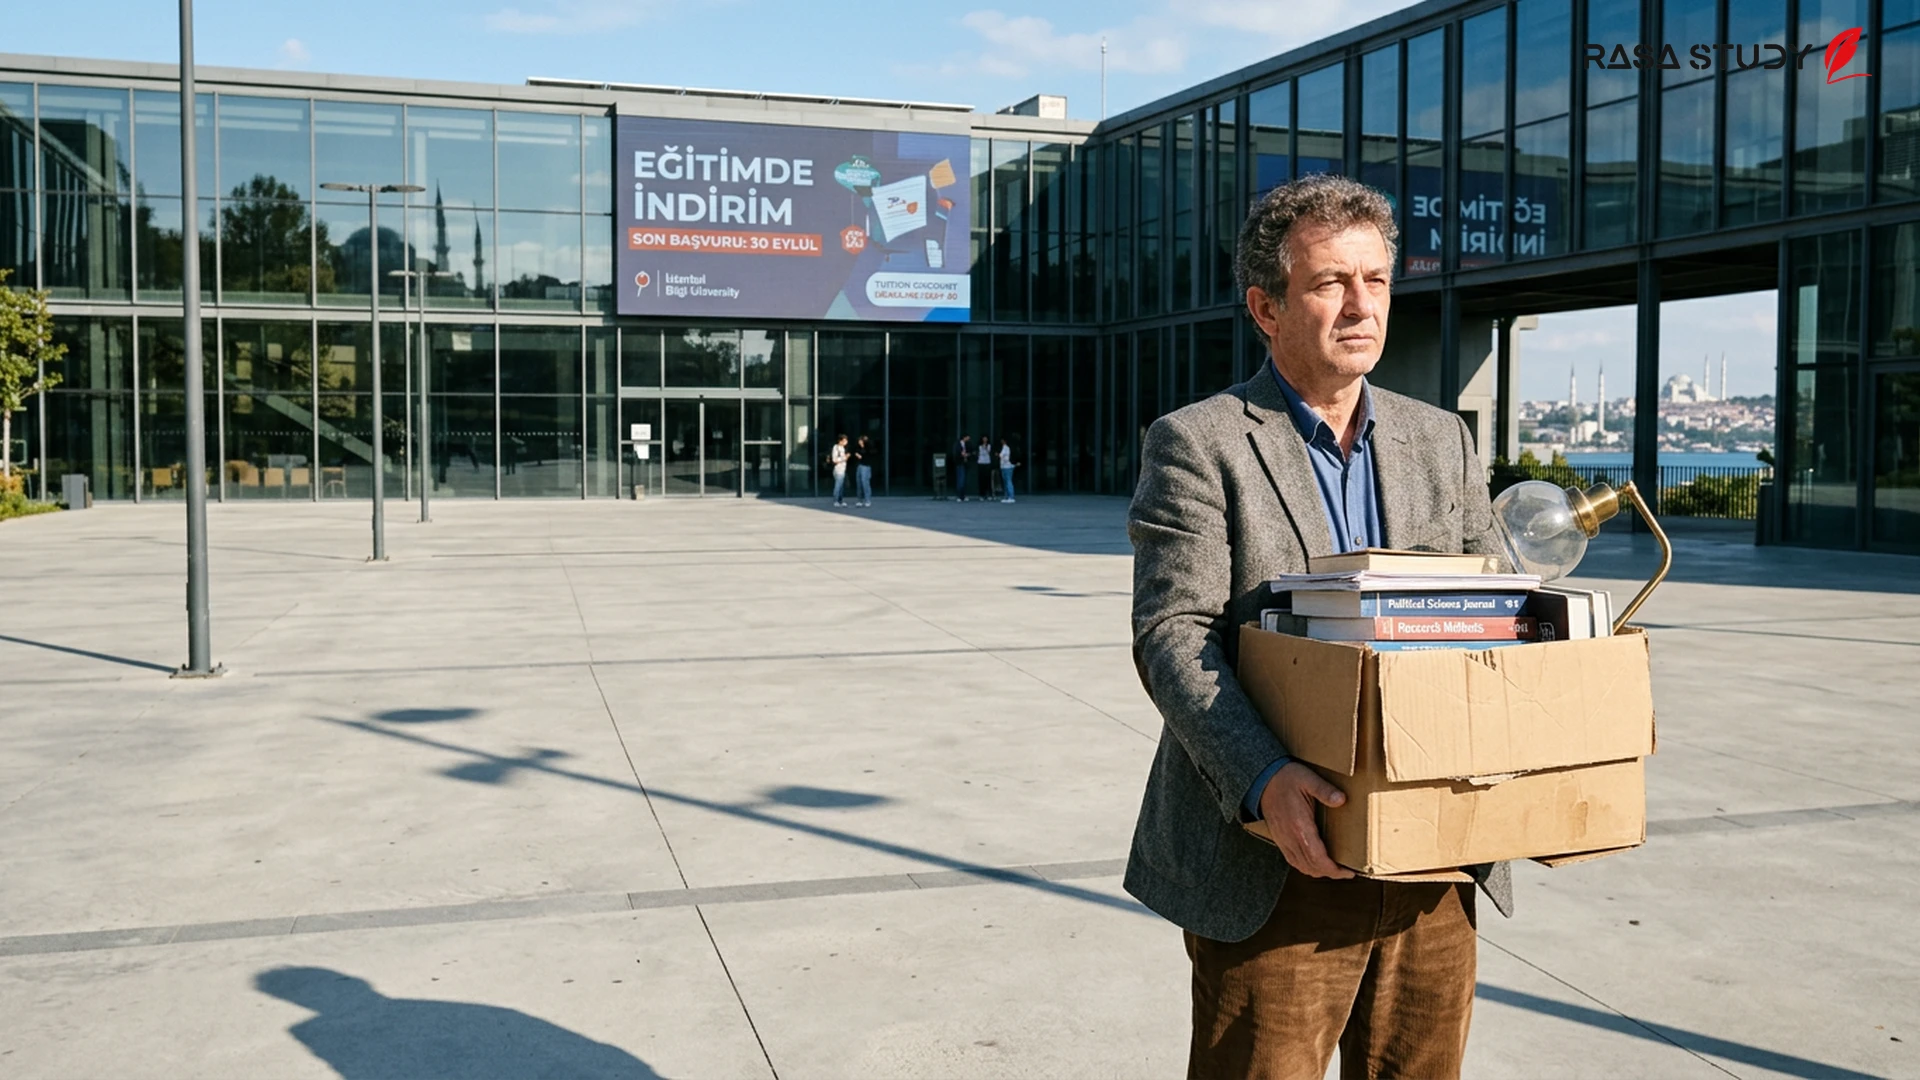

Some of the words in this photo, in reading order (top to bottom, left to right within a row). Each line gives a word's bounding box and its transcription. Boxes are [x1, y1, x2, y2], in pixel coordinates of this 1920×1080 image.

[634, 145, 814, 187] EĞİTİMDE
[634, 182, 793, 226] İNDİRİM
[632, 232, 666, 246] SON
[669, 234, 747, 250] BAŞVURU:
[750, 236, 769, 249] 30
